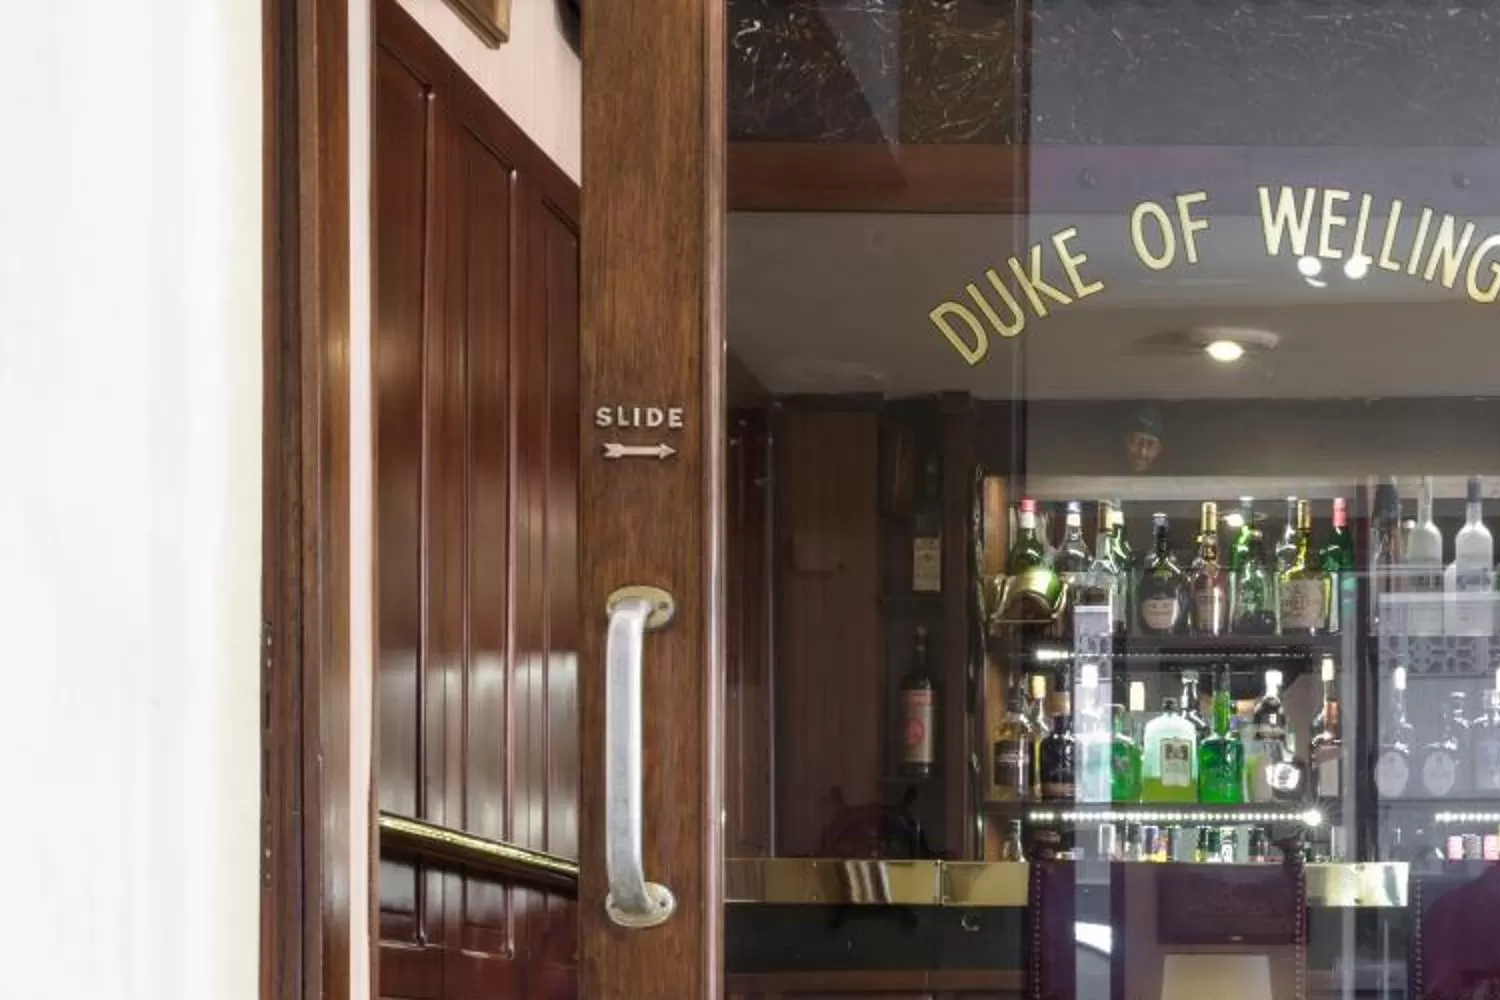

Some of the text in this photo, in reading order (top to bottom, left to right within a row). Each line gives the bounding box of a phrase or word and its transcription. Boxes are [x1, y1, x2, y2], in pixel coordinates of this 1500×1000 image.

[928, 227, 1104, 366] DUKE
[1130, 191, 1207, 271] OF
[595, 406, 684, 428] SLIDE
